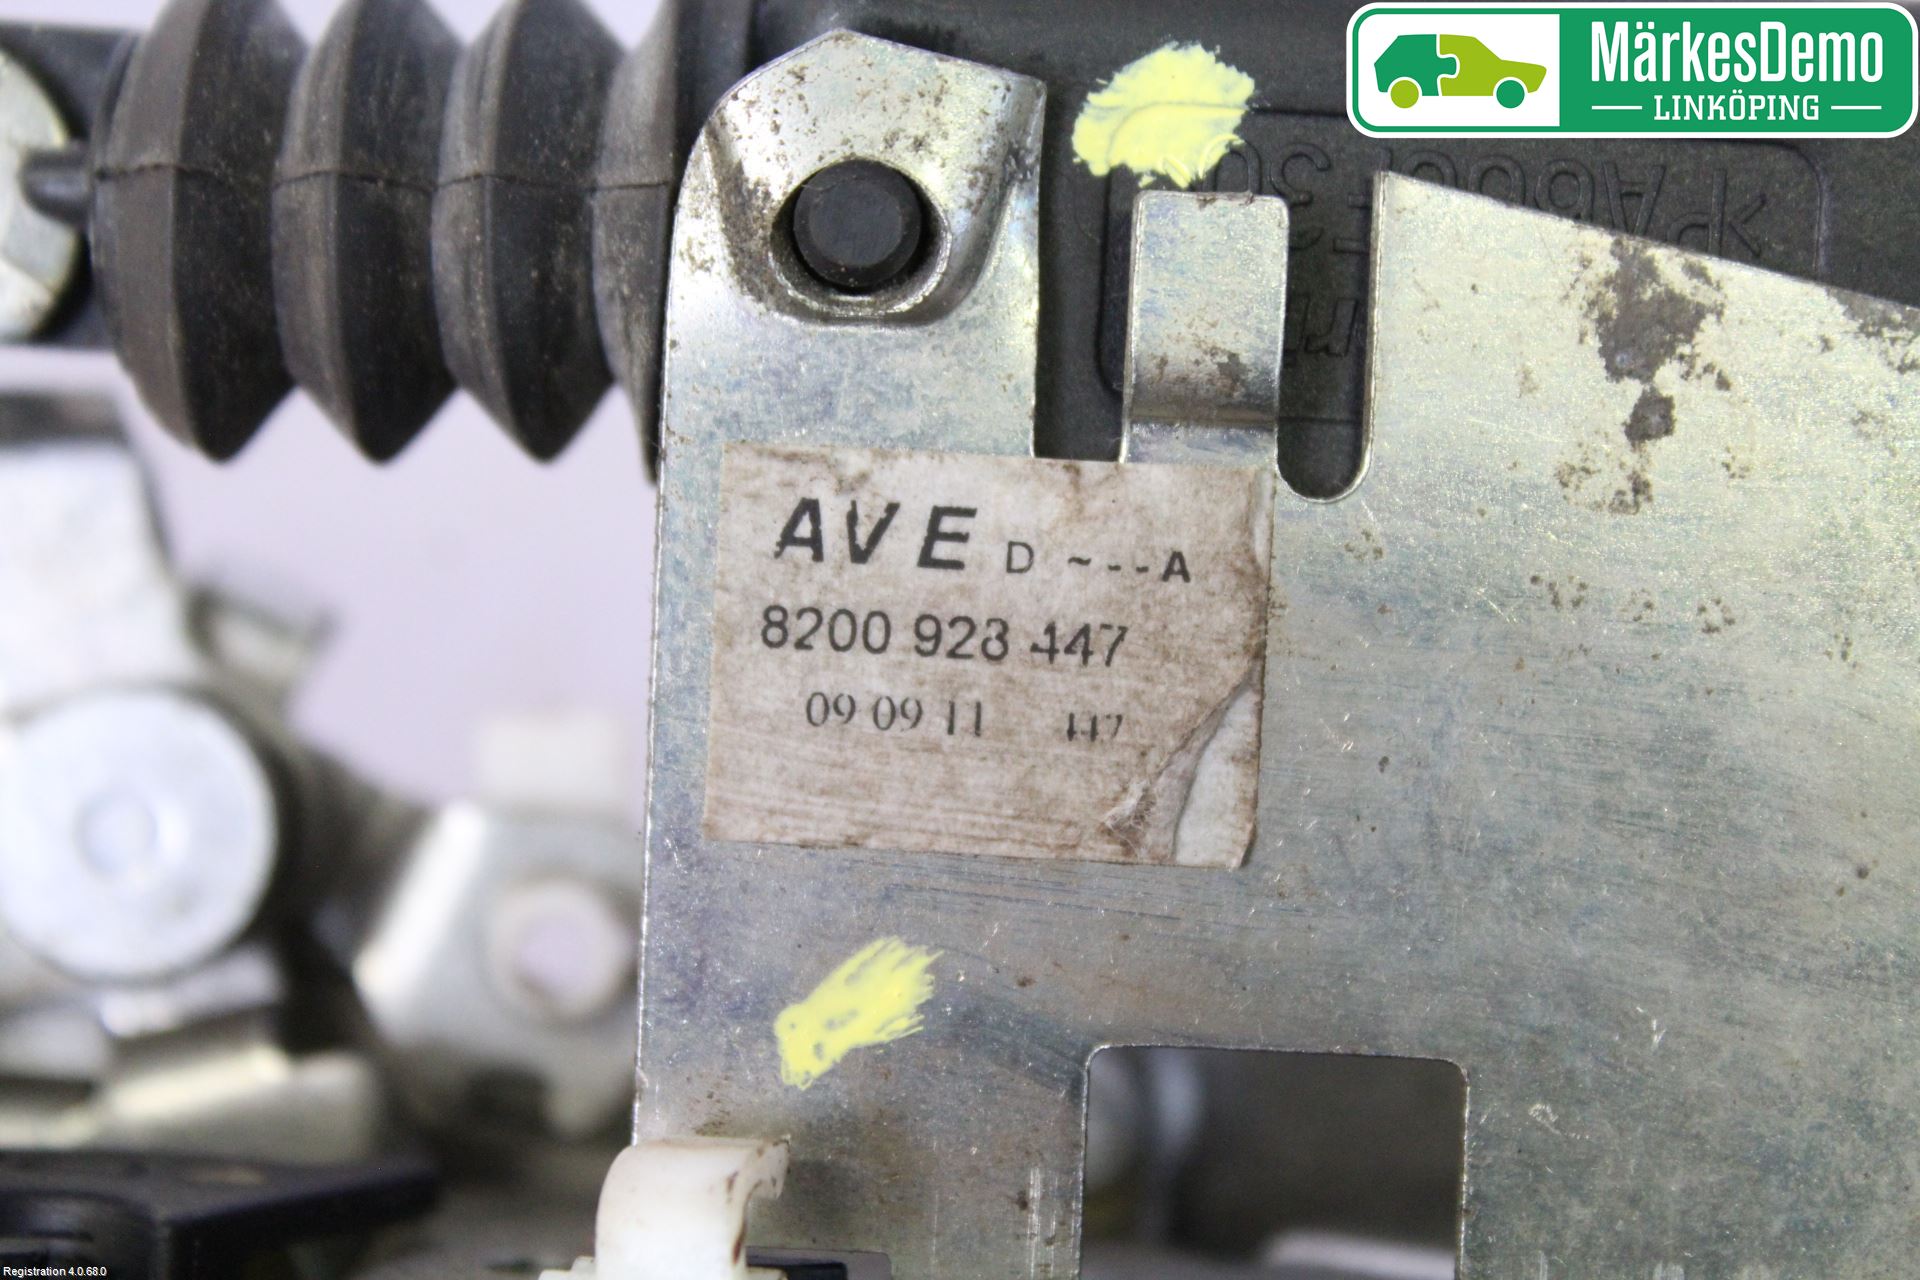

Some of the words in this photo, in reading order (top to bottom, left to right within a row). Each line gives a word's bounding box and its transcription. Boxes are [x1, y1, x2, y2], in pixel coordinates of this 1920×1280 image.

[774, 497, 978, 570] AVE
[761, 604, 892, 655] 8200
[806, 691, 857, 727] 09
[872, 694, 924, 732] 09
